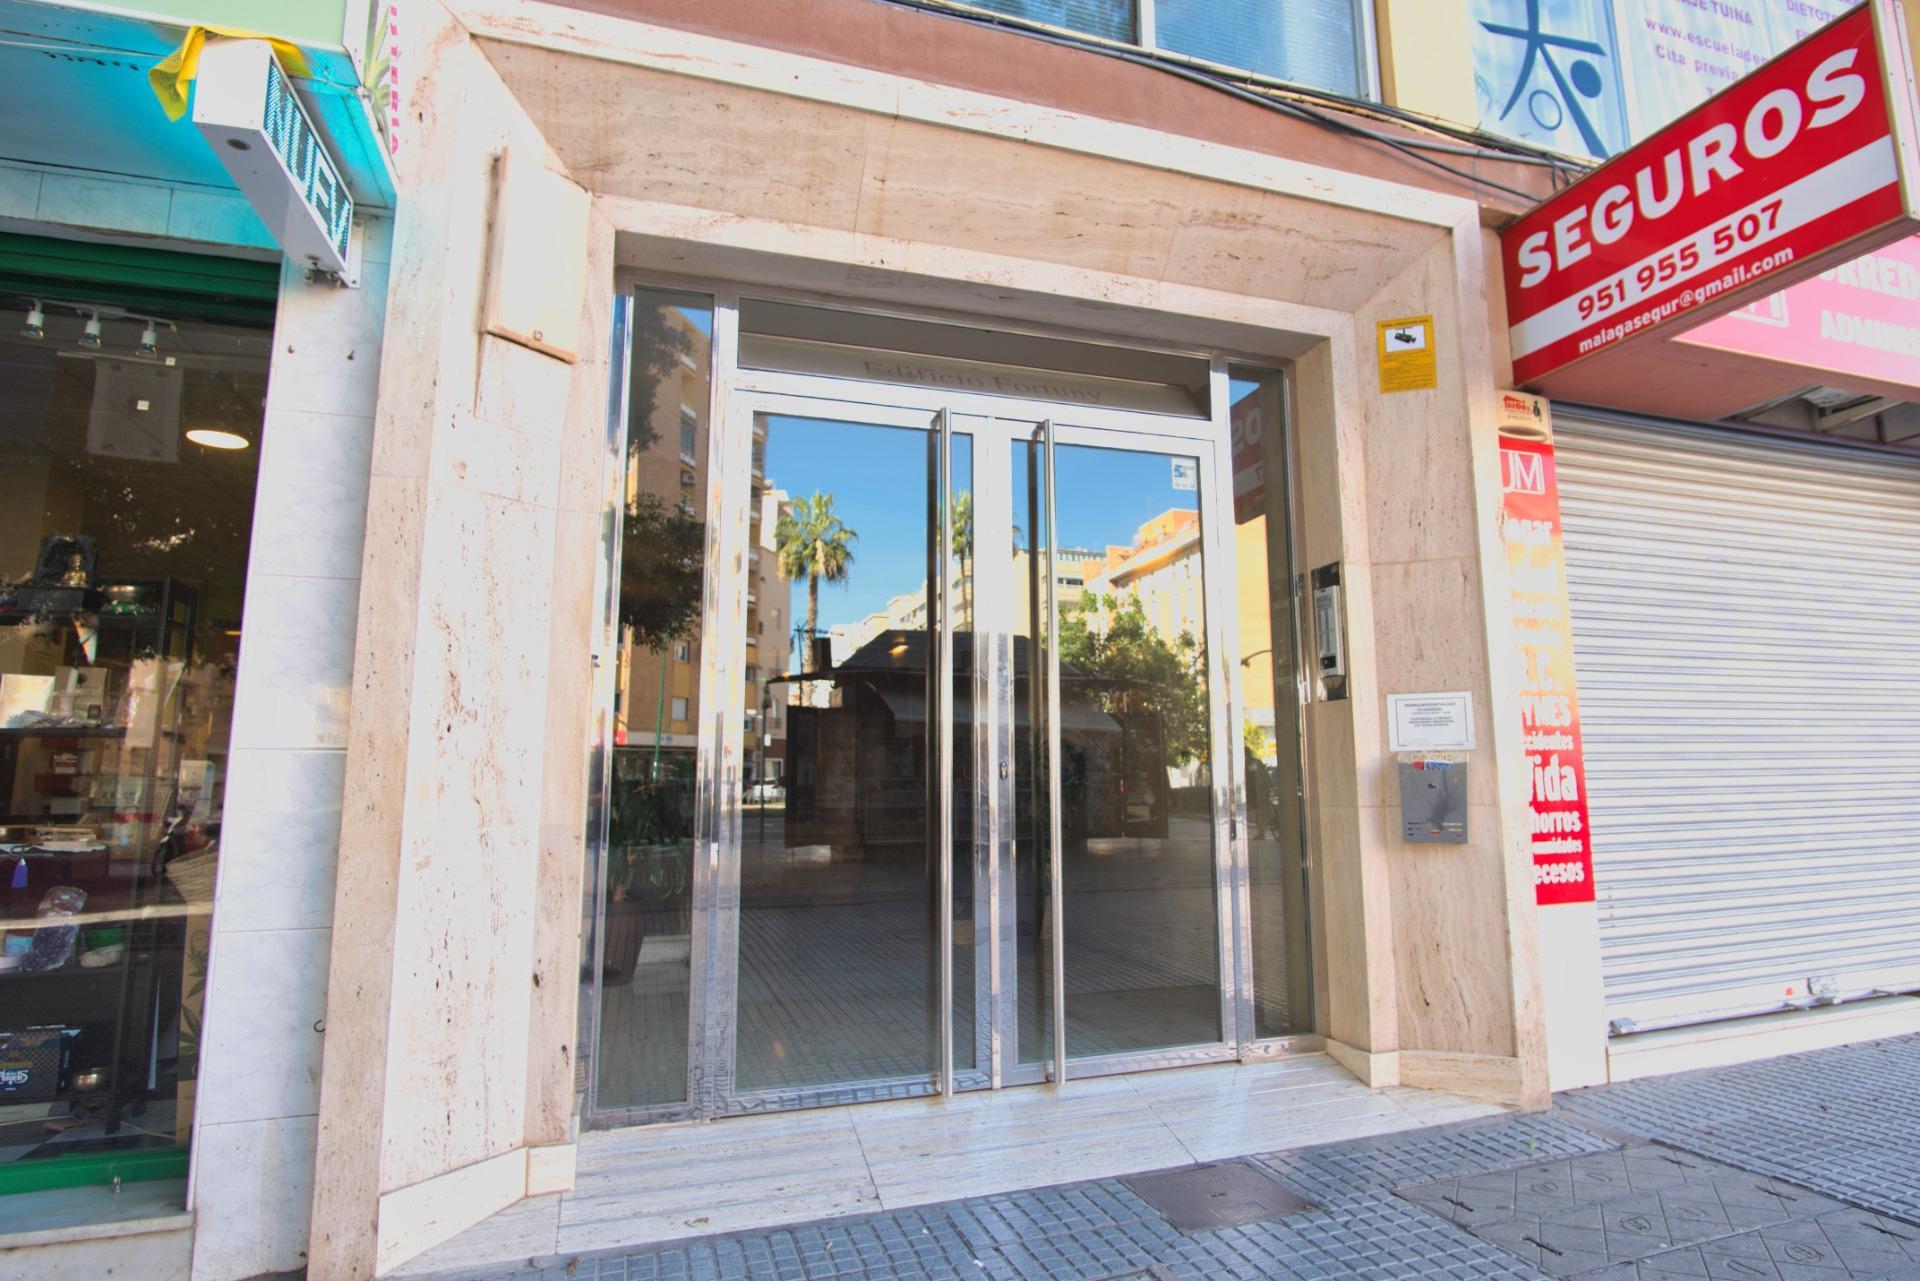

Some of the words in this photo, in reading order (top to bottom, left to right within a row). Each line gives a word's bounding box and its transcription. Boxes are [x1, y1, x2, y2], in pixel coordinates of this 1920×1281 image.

[1710, 0, 1754, 26] TUINA
[1655, 44, 1687, 66] Cita
[1694, 59, 1738, 81] previa
[1519, 47, 1866, 289] SEGUROS
[1578, 278, 1627, 320] 951
[1637, 242, 1700, 292] 955
[1715, 199, 1784, 254] 507
[1579, 247, 1794, 353] malagasegur@gmail.com
[864, 360, 983, 388] Edificio
[991, 375, 1101, 403] Fortuny
